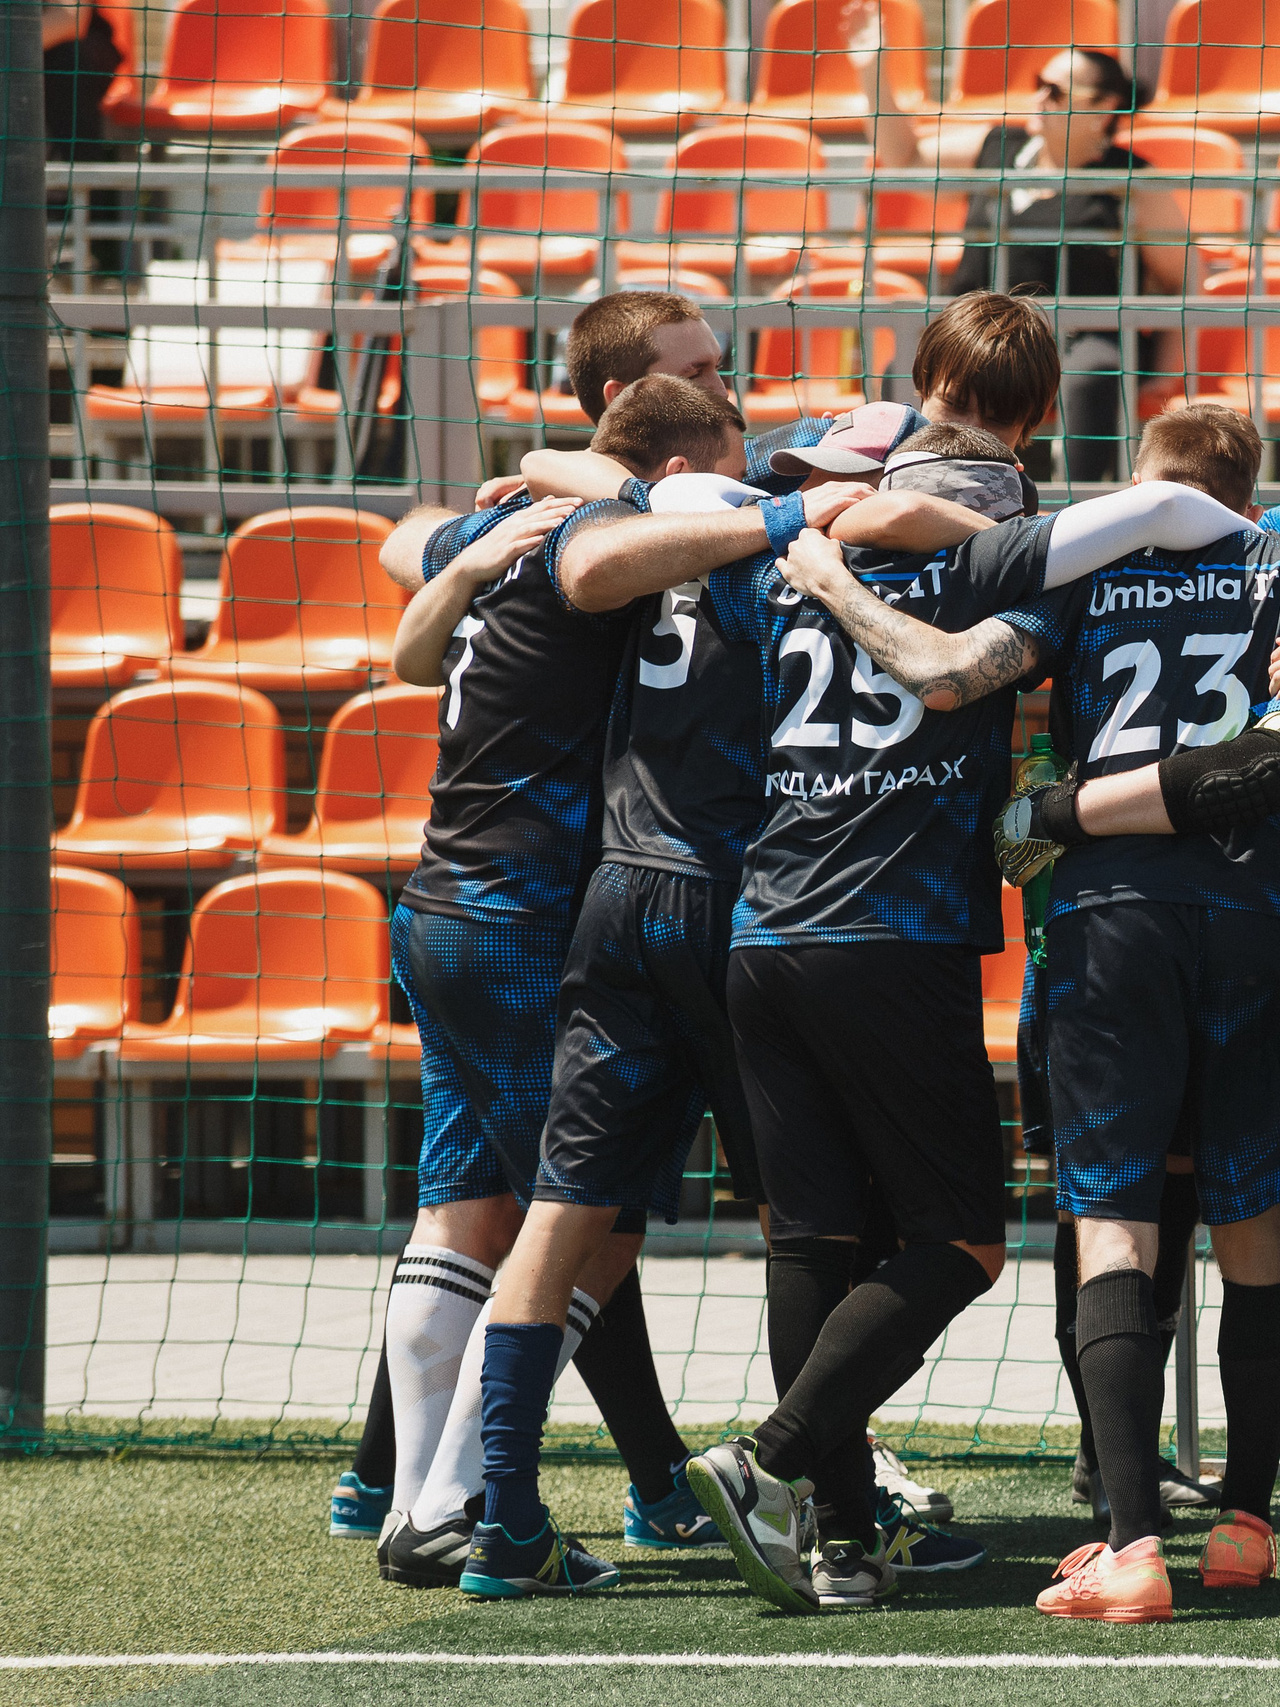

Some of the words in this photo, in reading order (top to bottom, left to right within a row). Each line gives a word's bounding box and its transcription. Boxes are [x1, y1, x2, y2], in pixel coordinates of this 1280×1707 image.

[638, 582, 701, 690] 5
[771, 628, 926, 750] 25
[1087, 630, 1254, 763] 23
